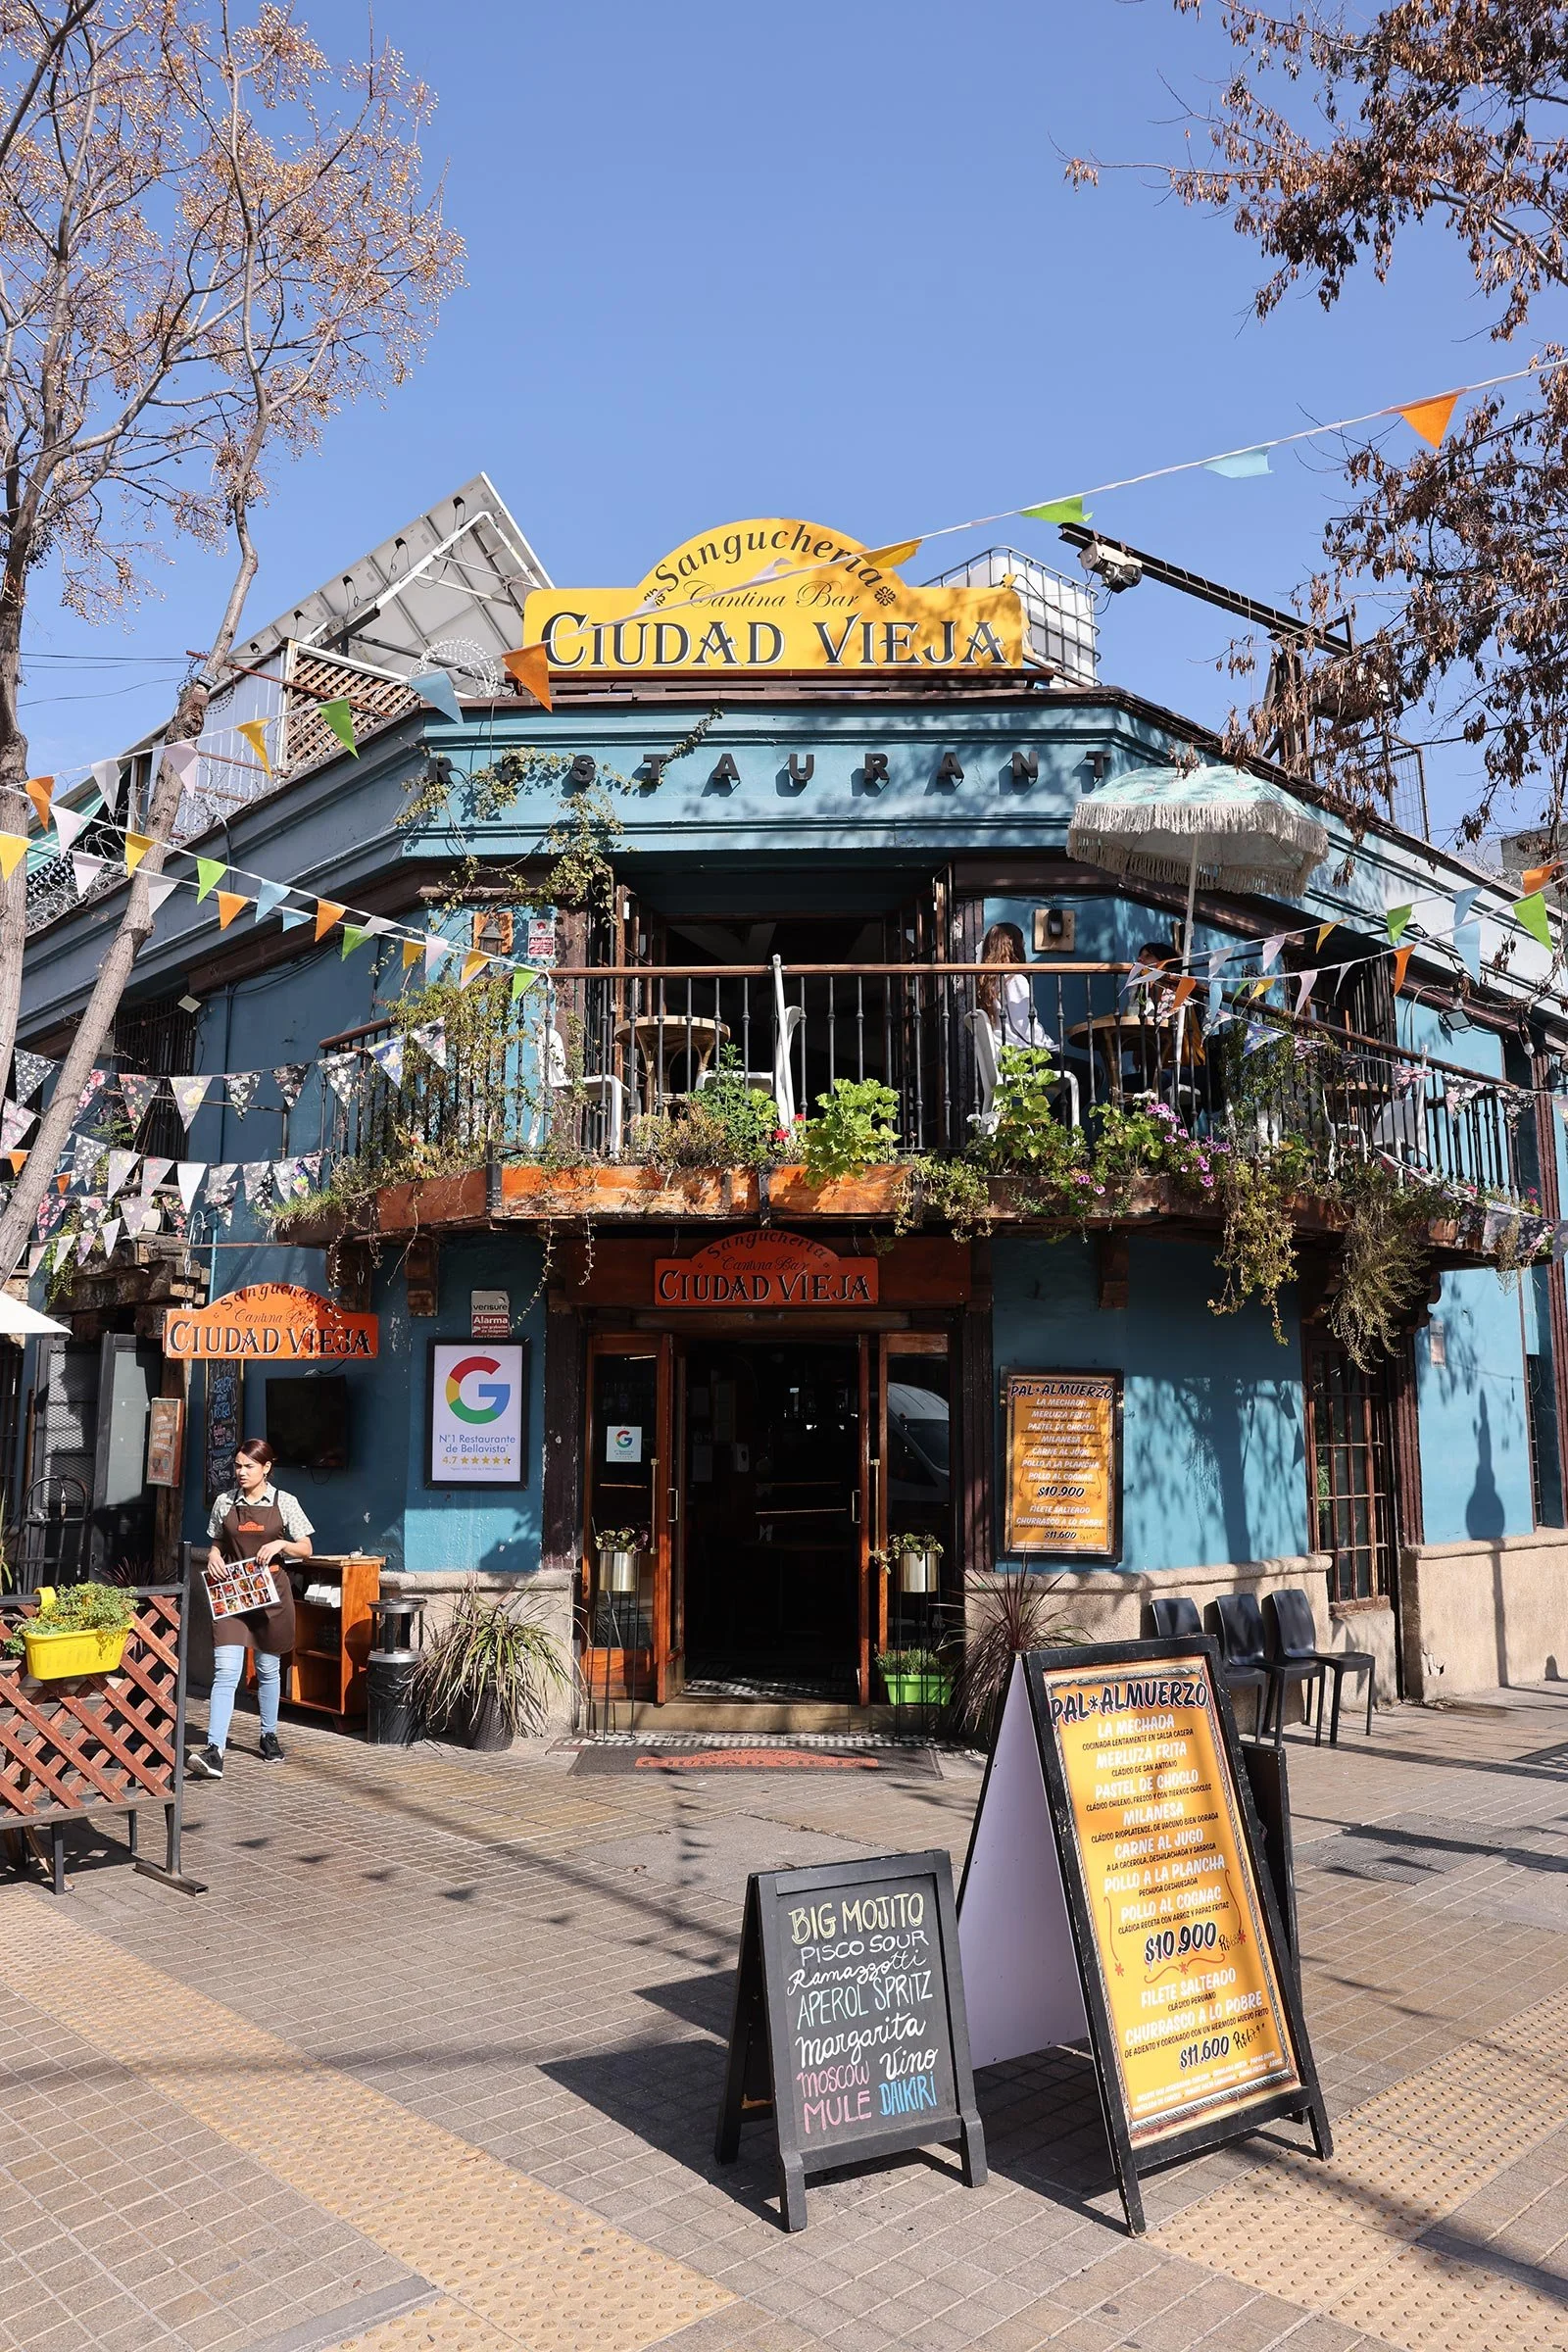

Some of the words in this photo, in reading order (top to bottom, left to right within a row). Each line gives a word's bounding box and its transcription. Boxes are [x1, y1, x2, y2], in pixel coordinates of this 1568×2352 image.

[683, 580, 789, 608] Cantina
[796, 580, 860, 608] Bar
[544, 612, 785, 668] CIUDAD
[814, 612, 1010, 667] VIEJA
[722, 1255, 772, 1271] Cantina
[775, 1255, 809, 1272] Bar
[659, 1270, 770, 1302] CIUDAD
[777, 1270, 870, 1301] VIEJA
[234, 1308, 282, 1323] Cantina
[170, 1321, 280, 1353] CIUDAD
[287, 1324, 373, 1354] VIEJA
[446, 1445, 458, 1453] de
[459, 1435, 515, 1444] Restaurante
[442, 1456, 458, 1465] 4.7
[1064, 1460, 1100, 1469] PLANCHA
[1038, 1485, 1085, 1497] $10.900
[1016, 1517, 1059, 1526] CHURRASCO
[1079, 1518, 1103, 1527] POBRE
[1044, 1530, 1077, 1540] $11.600
[1098, 1723, 1113, 1739] LA
[1116, 1714, 1174, 1736] MECHADA
[1096, 1746, 1152, 1769] MERLUZA
[1156, 1740, 1187, 1759] FRITA
[1095, 1780, 1135, 1799] PASTEL
[1142, 1777, 1153, 1790] DE
[1157, 1770, 1199, 1788] CHOCLO
[1123, 1801, 1184, 1826] MILANESA
[1114, 1838, 1154, 1858] CARNE
[1158, 1836, 1171, 1850] AL
[1174, 1829, 1204, 1846] JUGO
[1104, 1873, 1140, 1893] POLLO
[1144, 1870, 1151, 1885] A
[1154, 1867, 1168, 1882] LA
[1172, 1855, 1225, 1878] PLANCHA
[788, 1902, 837, 1945] BIG
[842, 1892, 924, 1935] MOJITO
[1121, 1901, 1156, 1922] POLLO
[1160, 1897, 1173, 1912] AL
[1177, 1886, 1221, 1907] COGNAC
[800, 1940, 865, 1967] PISCO
[869, 1930, 929, 1953] SOUR
[1145, 1921, 1218, 1971] $10.900
[787, 1949, 926, 1996] Ramazzotti
[1141, 1984, 1178, 2007] FILETE
[1180, 1968, 1237, 1995] SALTEADO
[798, 1984, 869, 2030] APEROL
[873, 1971, 933, 2011] SPRITZ
[1126, 2012, 1196, 2045] CHURRASCO
[1199, 2008, 1205, 2023] A
[1210, 2003, 1223, 2020] LO
[1226, 1992, 1263, 2014] POBRE
[879, 2046, 938, 2081] Vino
[1179, 2035, 1230, 2071] $11.600
[804, 2089, 871, 2134] MULE
